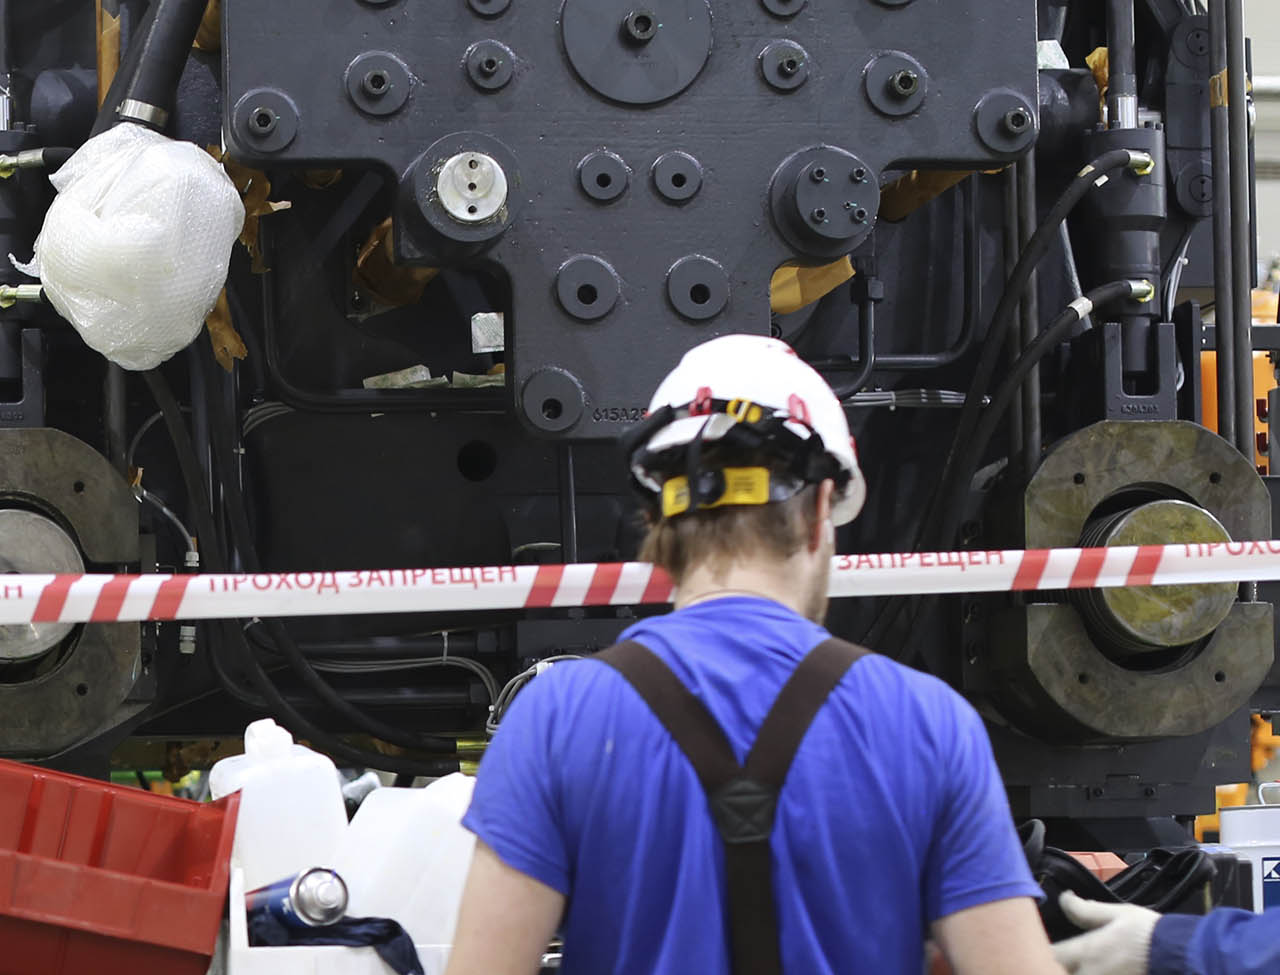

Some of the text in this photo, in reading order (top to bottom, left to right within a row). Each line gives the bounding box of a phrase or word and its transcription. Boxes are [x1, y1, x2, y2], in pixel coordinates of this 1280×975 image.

[837, 550, 1005, 571] ЗАПРЕЩЕН
[209, 565, 518, 594] ПРОХОД ЗАПРЕЩЕН
